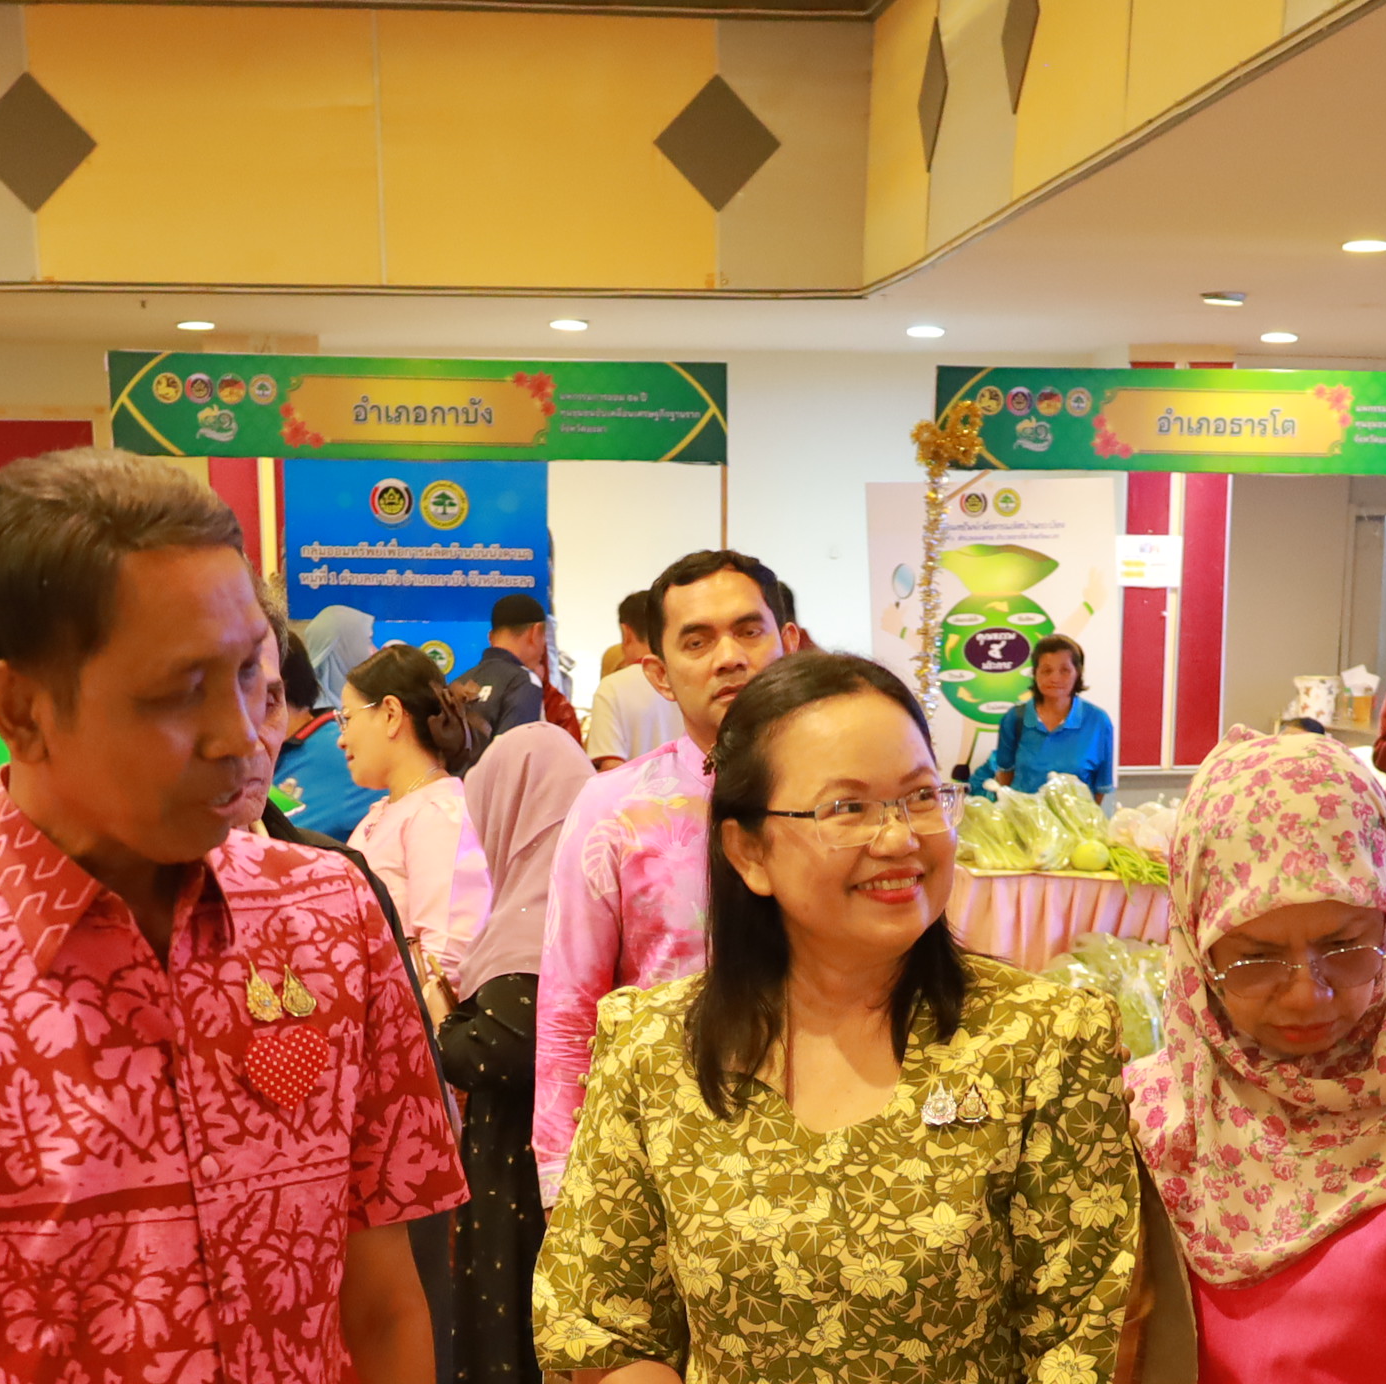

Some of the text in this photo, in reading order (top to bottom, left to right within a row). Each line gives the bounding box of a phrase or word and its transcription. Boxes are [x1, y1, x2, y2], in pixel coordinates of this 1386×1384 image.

[353, 395, 493, 426] อำเภอกาบัง
[1157, 407, 1297, 437] อำเภอธารโต
